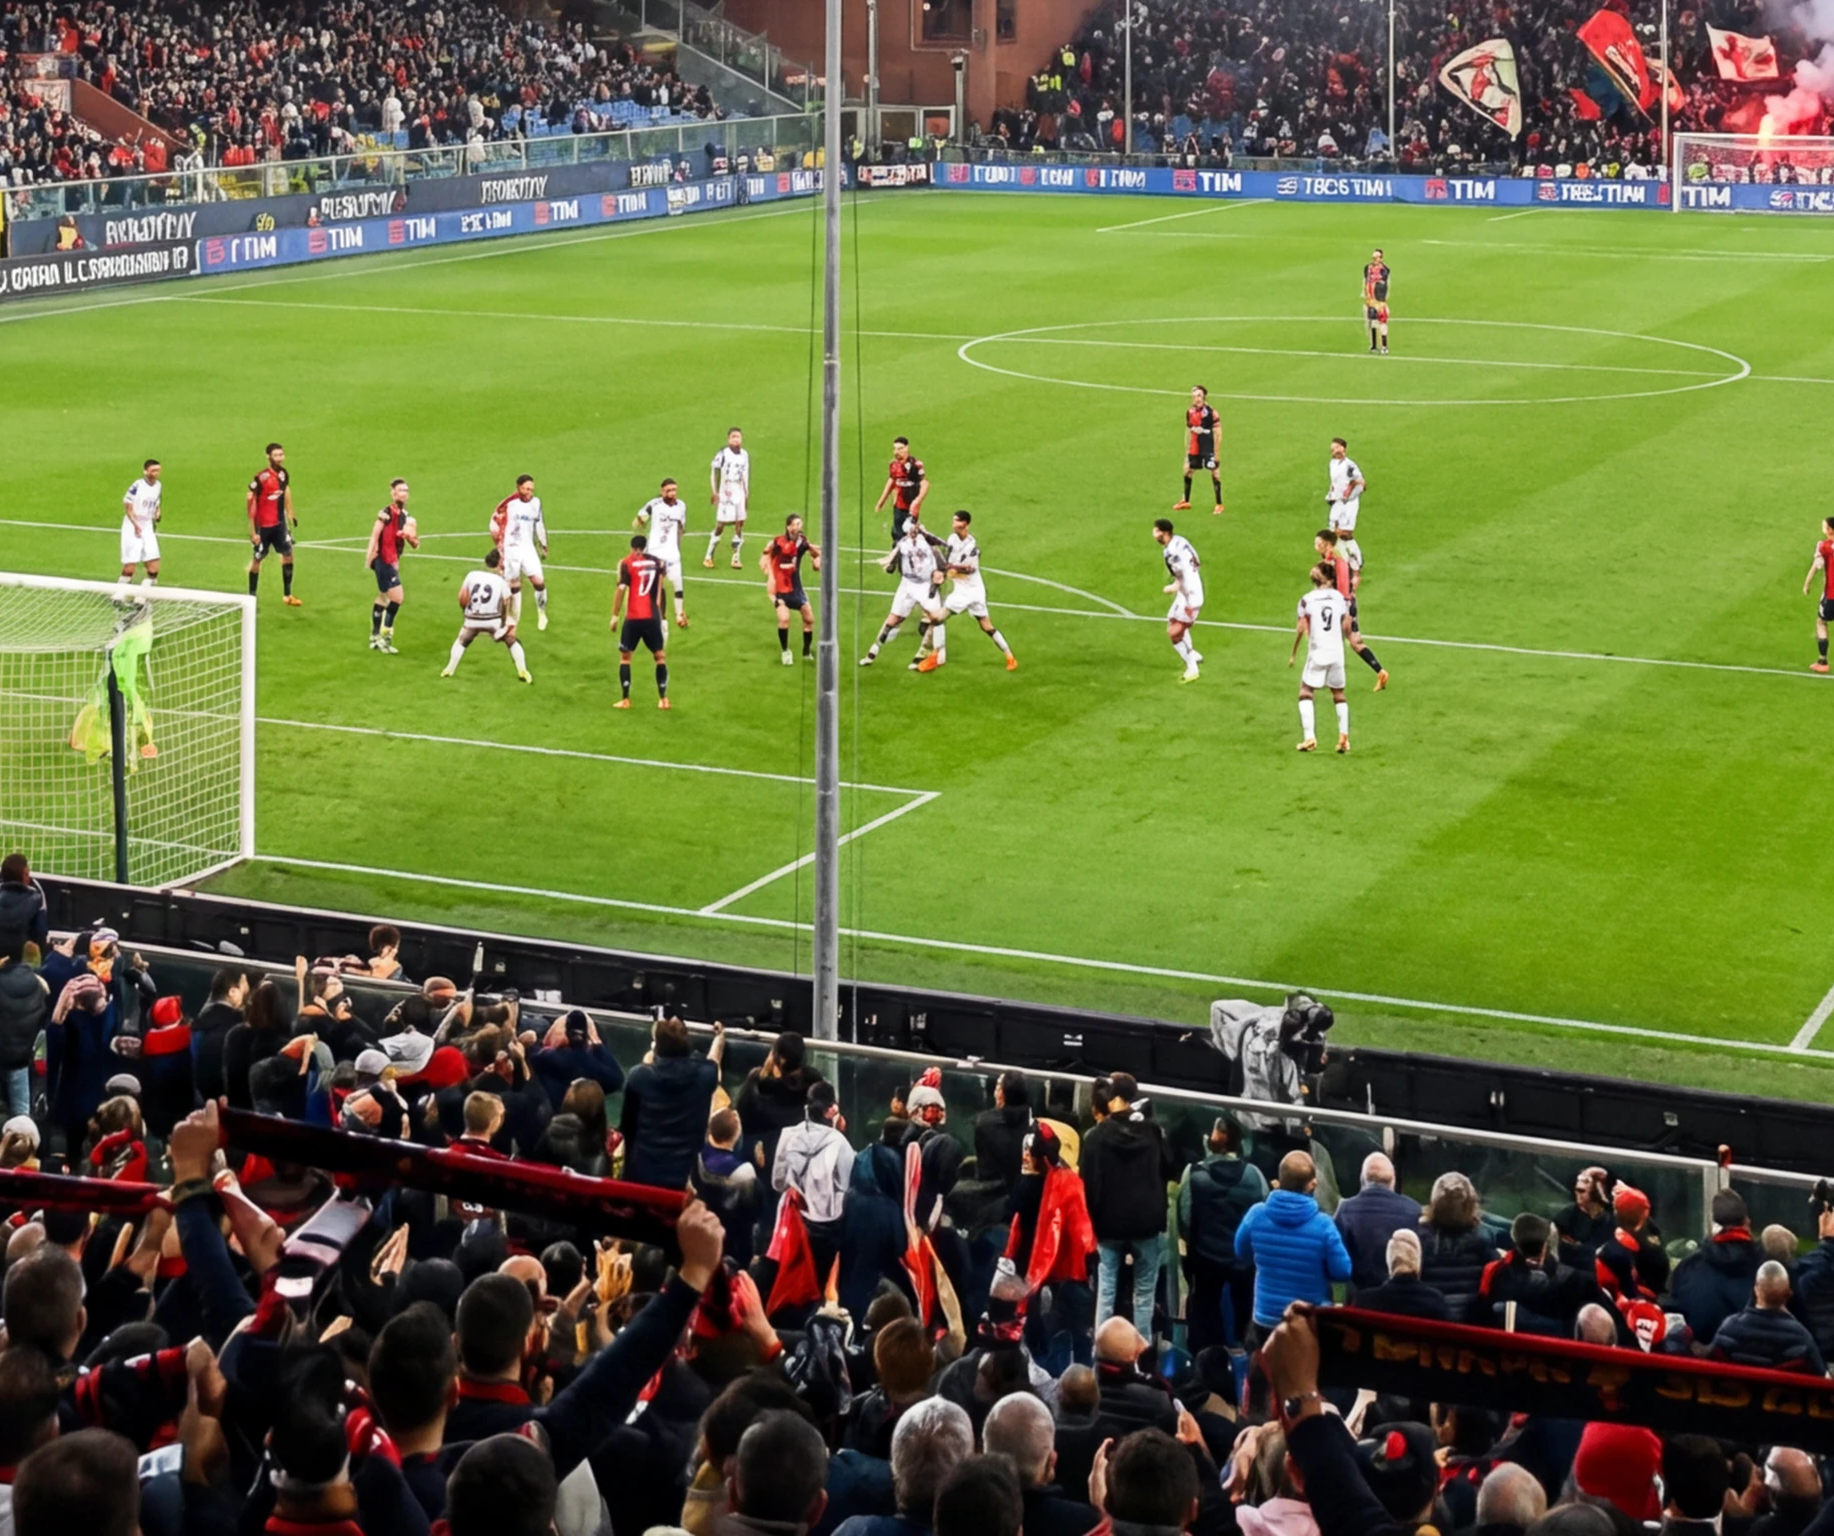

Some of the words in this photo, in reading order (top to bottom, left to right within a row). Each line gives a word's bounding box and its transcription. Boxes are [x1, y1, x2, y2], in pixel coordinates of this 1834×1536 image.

[1199, 171, 1242, 192] TIM
[1449, 179, 1495, 200] TIM
[1682, 185, 1731, 207] TIM
[1321, 606, 1333, 632] 9
